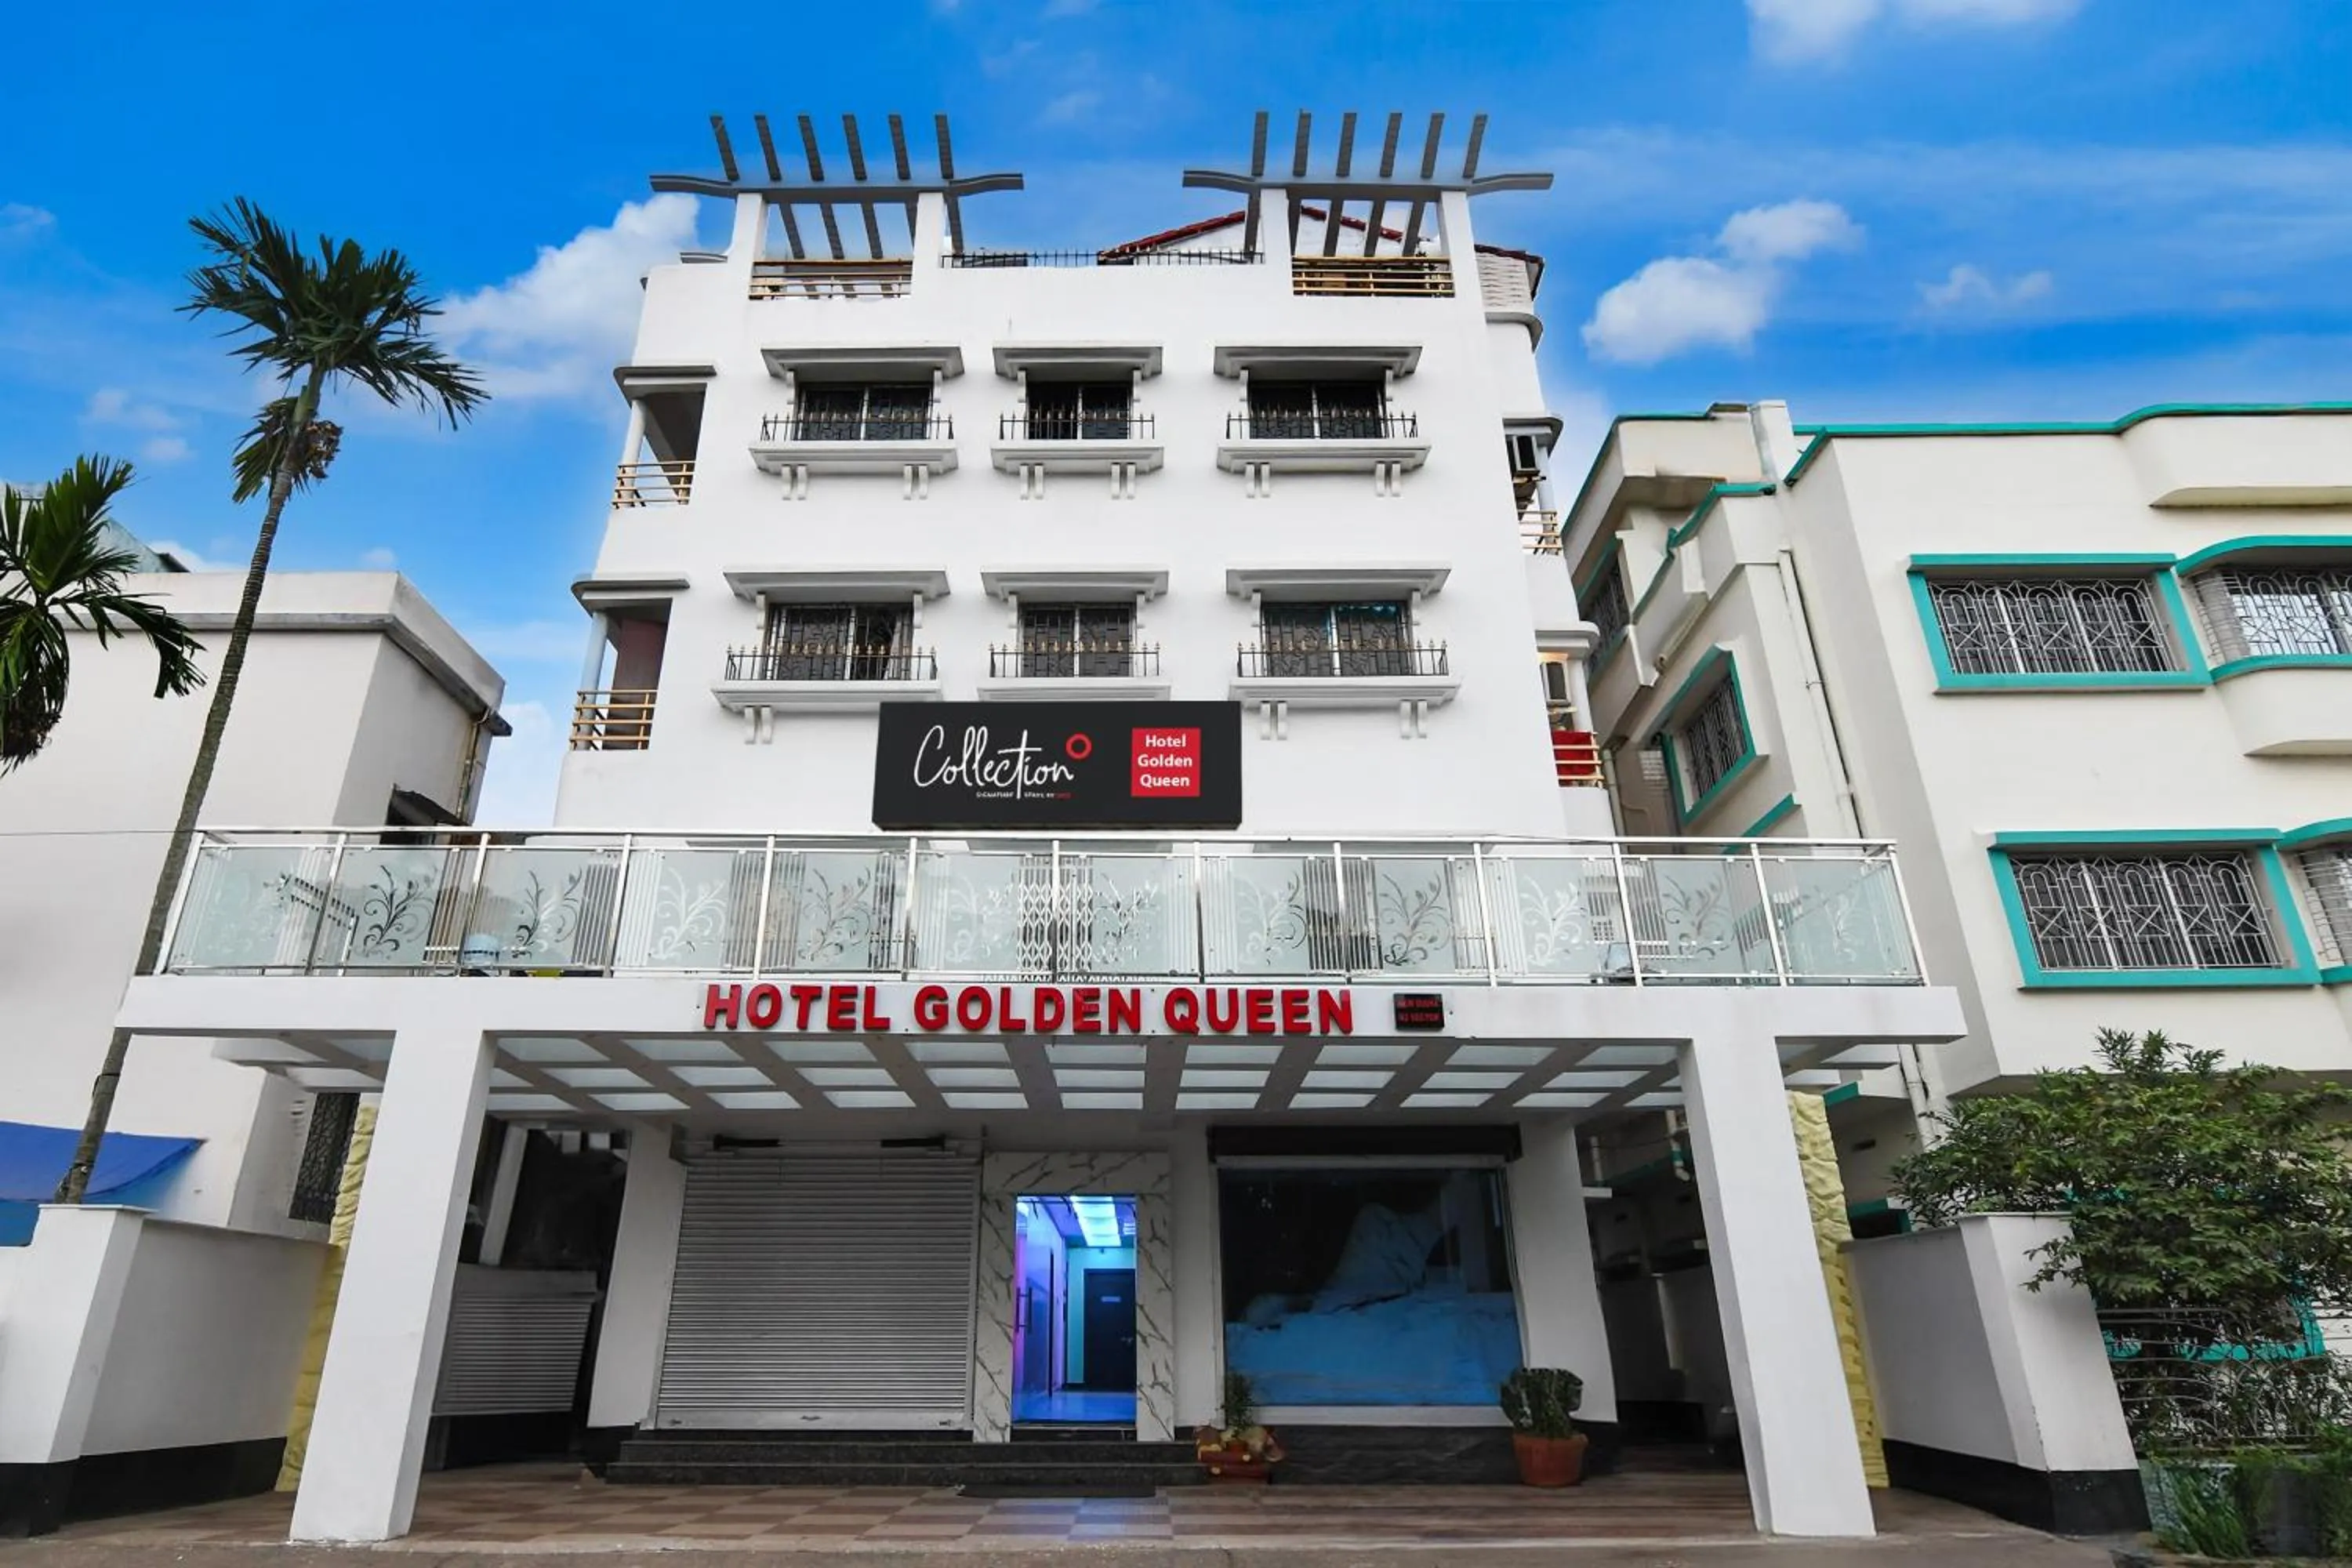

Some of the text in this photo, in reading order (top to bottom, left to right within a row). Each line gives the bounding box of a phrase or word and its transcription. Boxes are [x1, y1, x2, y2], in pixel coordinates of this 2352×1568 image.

[1145, 733, 1186, 747] Hotel
[913, 724, 1075, 800] Collection
[1138, 753, 1192, 767] Golden
[1140, 774, 1190, 788] Queen
[703, 985, 1354, 1034] HOTEL GOLDEN QUEEN
